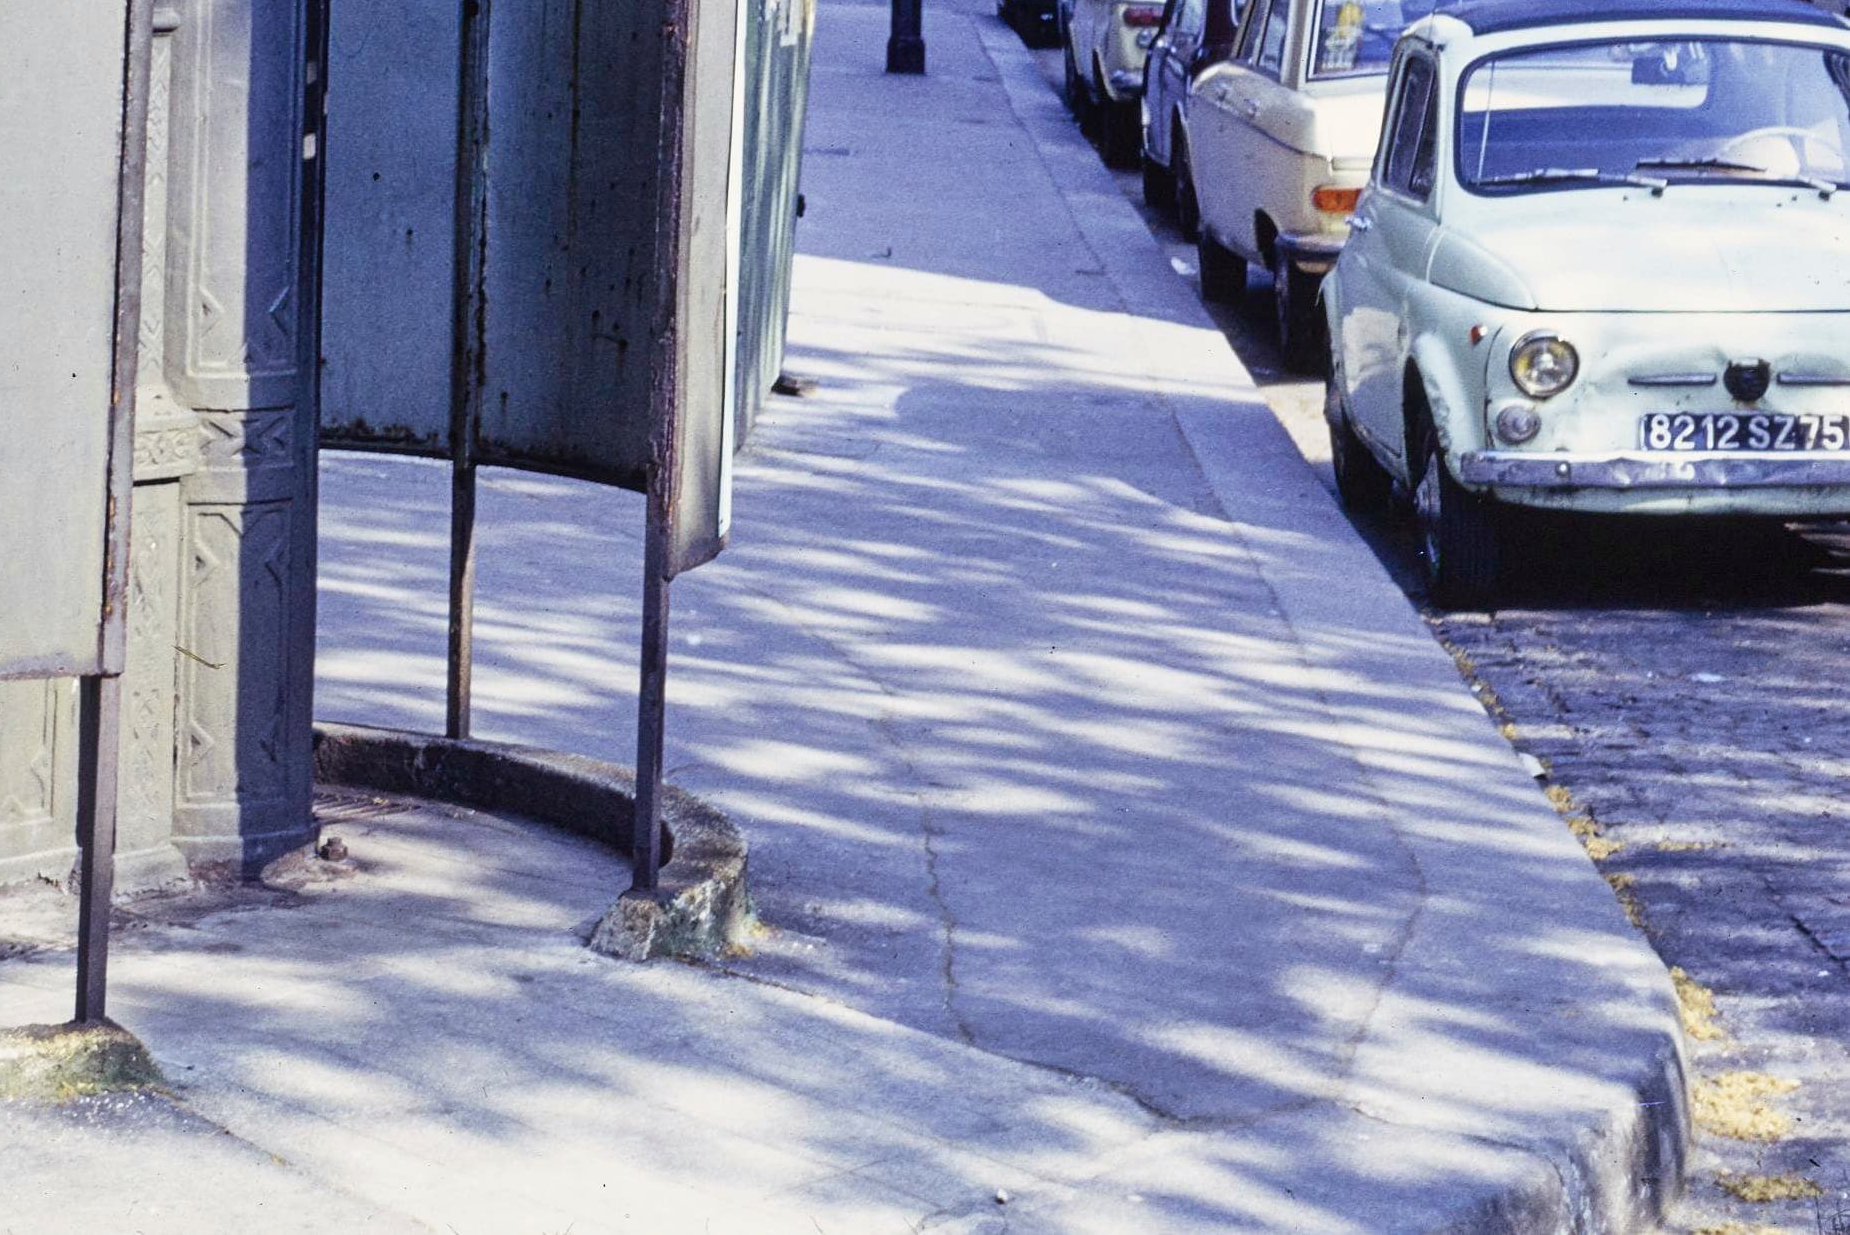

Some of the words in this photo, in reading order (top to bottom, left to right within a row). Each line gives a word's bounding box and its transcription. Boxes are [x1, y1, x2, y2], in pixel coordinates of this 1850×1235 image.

[1649, 414, 1740, 450] 8212
[1748, 415, 1796, 450] SZ
[1798, 416, 1845, 450] 75
